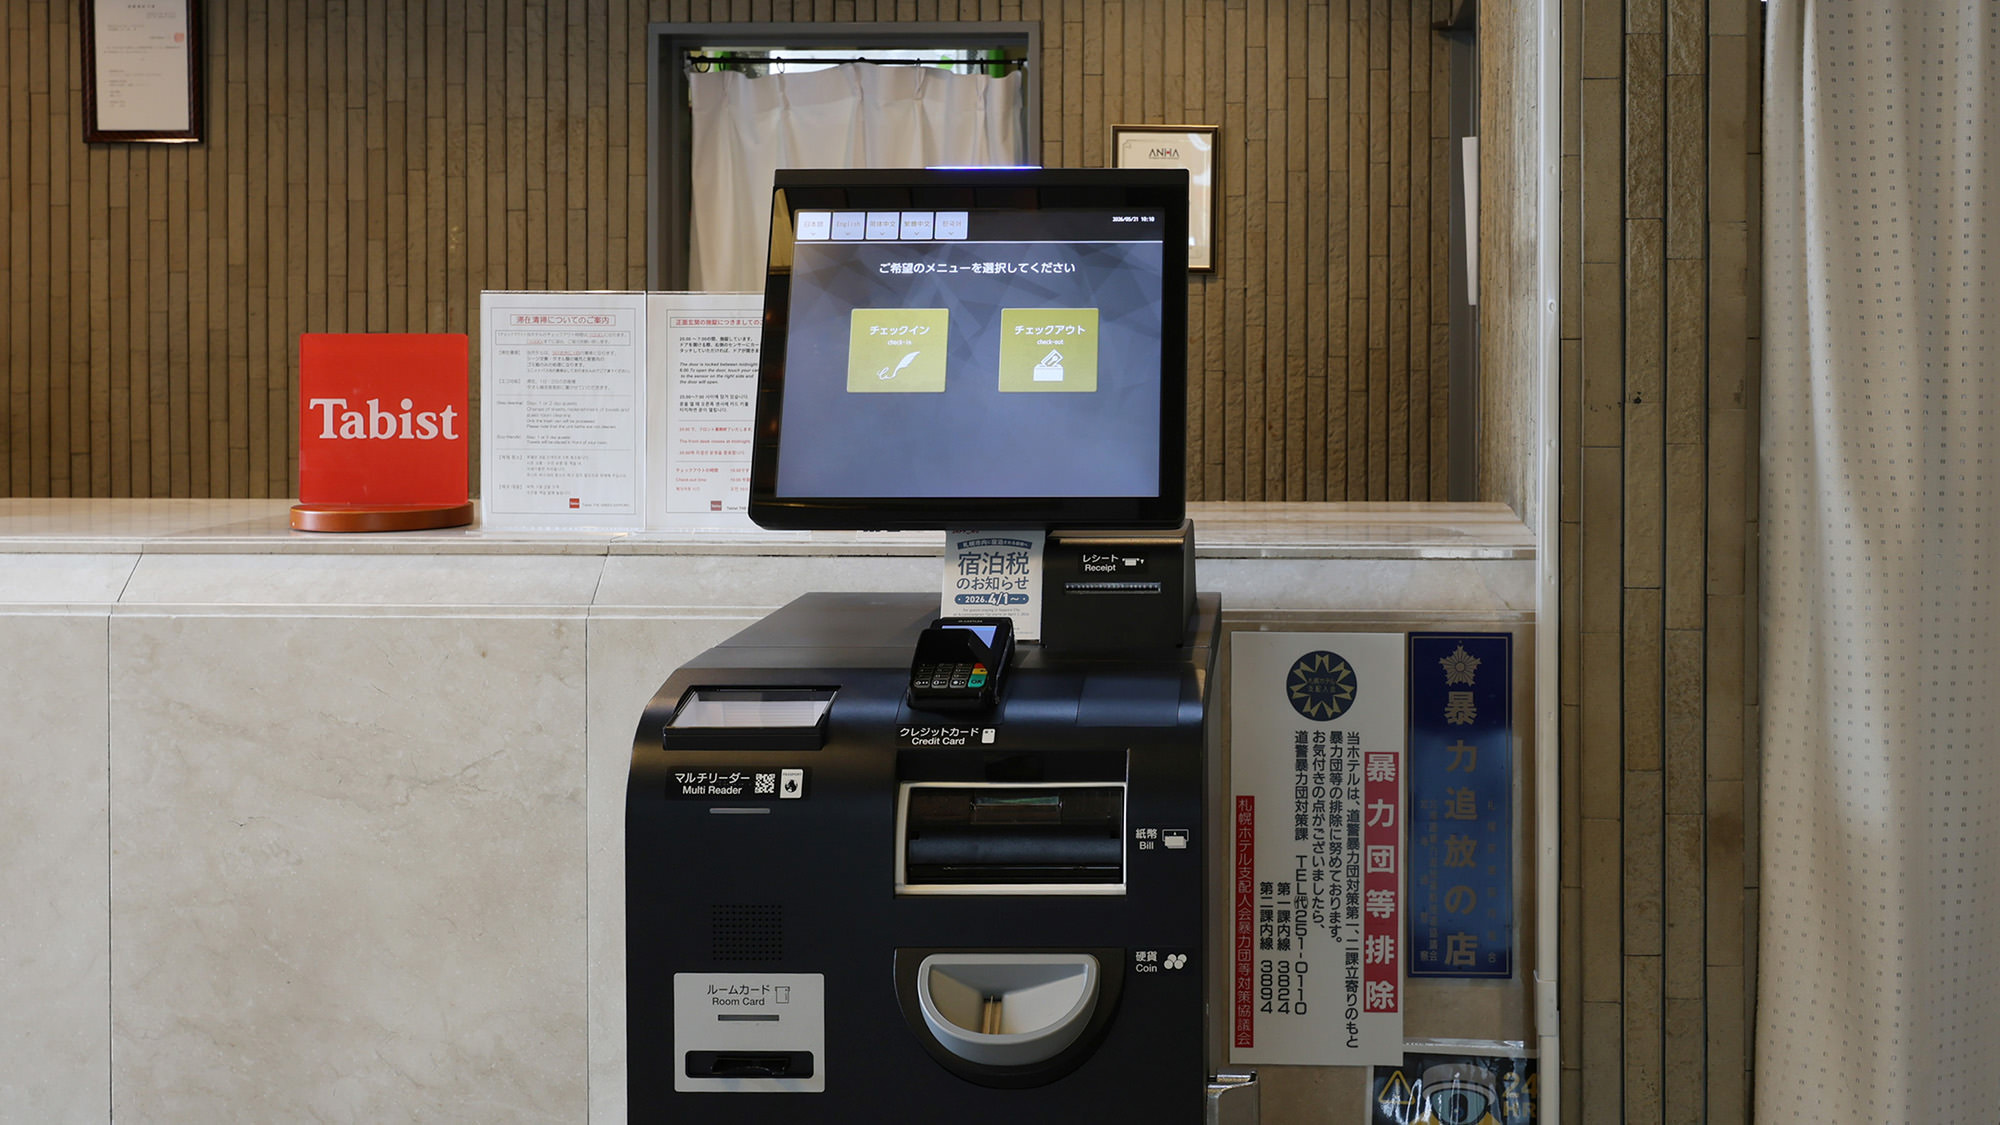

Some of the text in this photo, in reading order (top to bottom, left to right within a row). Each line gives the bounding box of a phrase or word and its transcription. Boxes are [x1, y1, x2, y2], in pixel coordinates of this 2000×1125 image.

[1149, 148, 1180, 157] ANHA
[836, 220, 861, 229] English
[879, 261, 1076, 276] ご希望のメニューを選択してください
[516, 315, 610, 325] 滞在清掃についてのご案内
[869, 325, 930, 335] チェックイン
[1014, 325, 1087, 335] チェックアウト
[309, 398, 459, 440] Tabist
[958, 551, 1030, 576] 宿泊税
[1082, 554, 1119, 563] レシート
[1084, 564, 1117, 573] Receipt
[956, 576, 1030, 591] のお知らせ
[900, 727, 979, 737] クレジットカード
[911, 737, 966, 746] Credit Card
[675, 772, 751, 784] マルチリーダー
[682, 786, 743, 795] Multi Reader
[1295, 730, 1309, 841] 道警暴力団対策課
[1135, 828, 1158, 840] 紙幣
[1311, 730, 1326, 929] お気付きの点がございましたら、
[1443, 690, 1478, 967] 暴力追放の店
[1328, 730, 1343, 943] 暴力団等の排除に努めております。
[1139, 841, 1155, 850] Bill
[1365, 753, 1396, 1010] 暴力団等排除
[1345, 731, 1361, 1048] 当ホテルは、道警暴力団対策第一、二課立寄りのもと
[1236, 798, 1252, 1046] 札幌ホテル支配人会暴力団等対策協議会
[1259, 881, 1274, 1014] 第二課内線 3894
[1277, 882, 1291, 1014] 第一課内線 3824
[1135, 951, 1158, 962] 硬貨
[1135, 964, 1158, 973] Coin
[706, 984, 770, 996] ルームカード
[712, 997, 765, 1006] Room Card
[1502, 1071, 1538, 1098] 24
